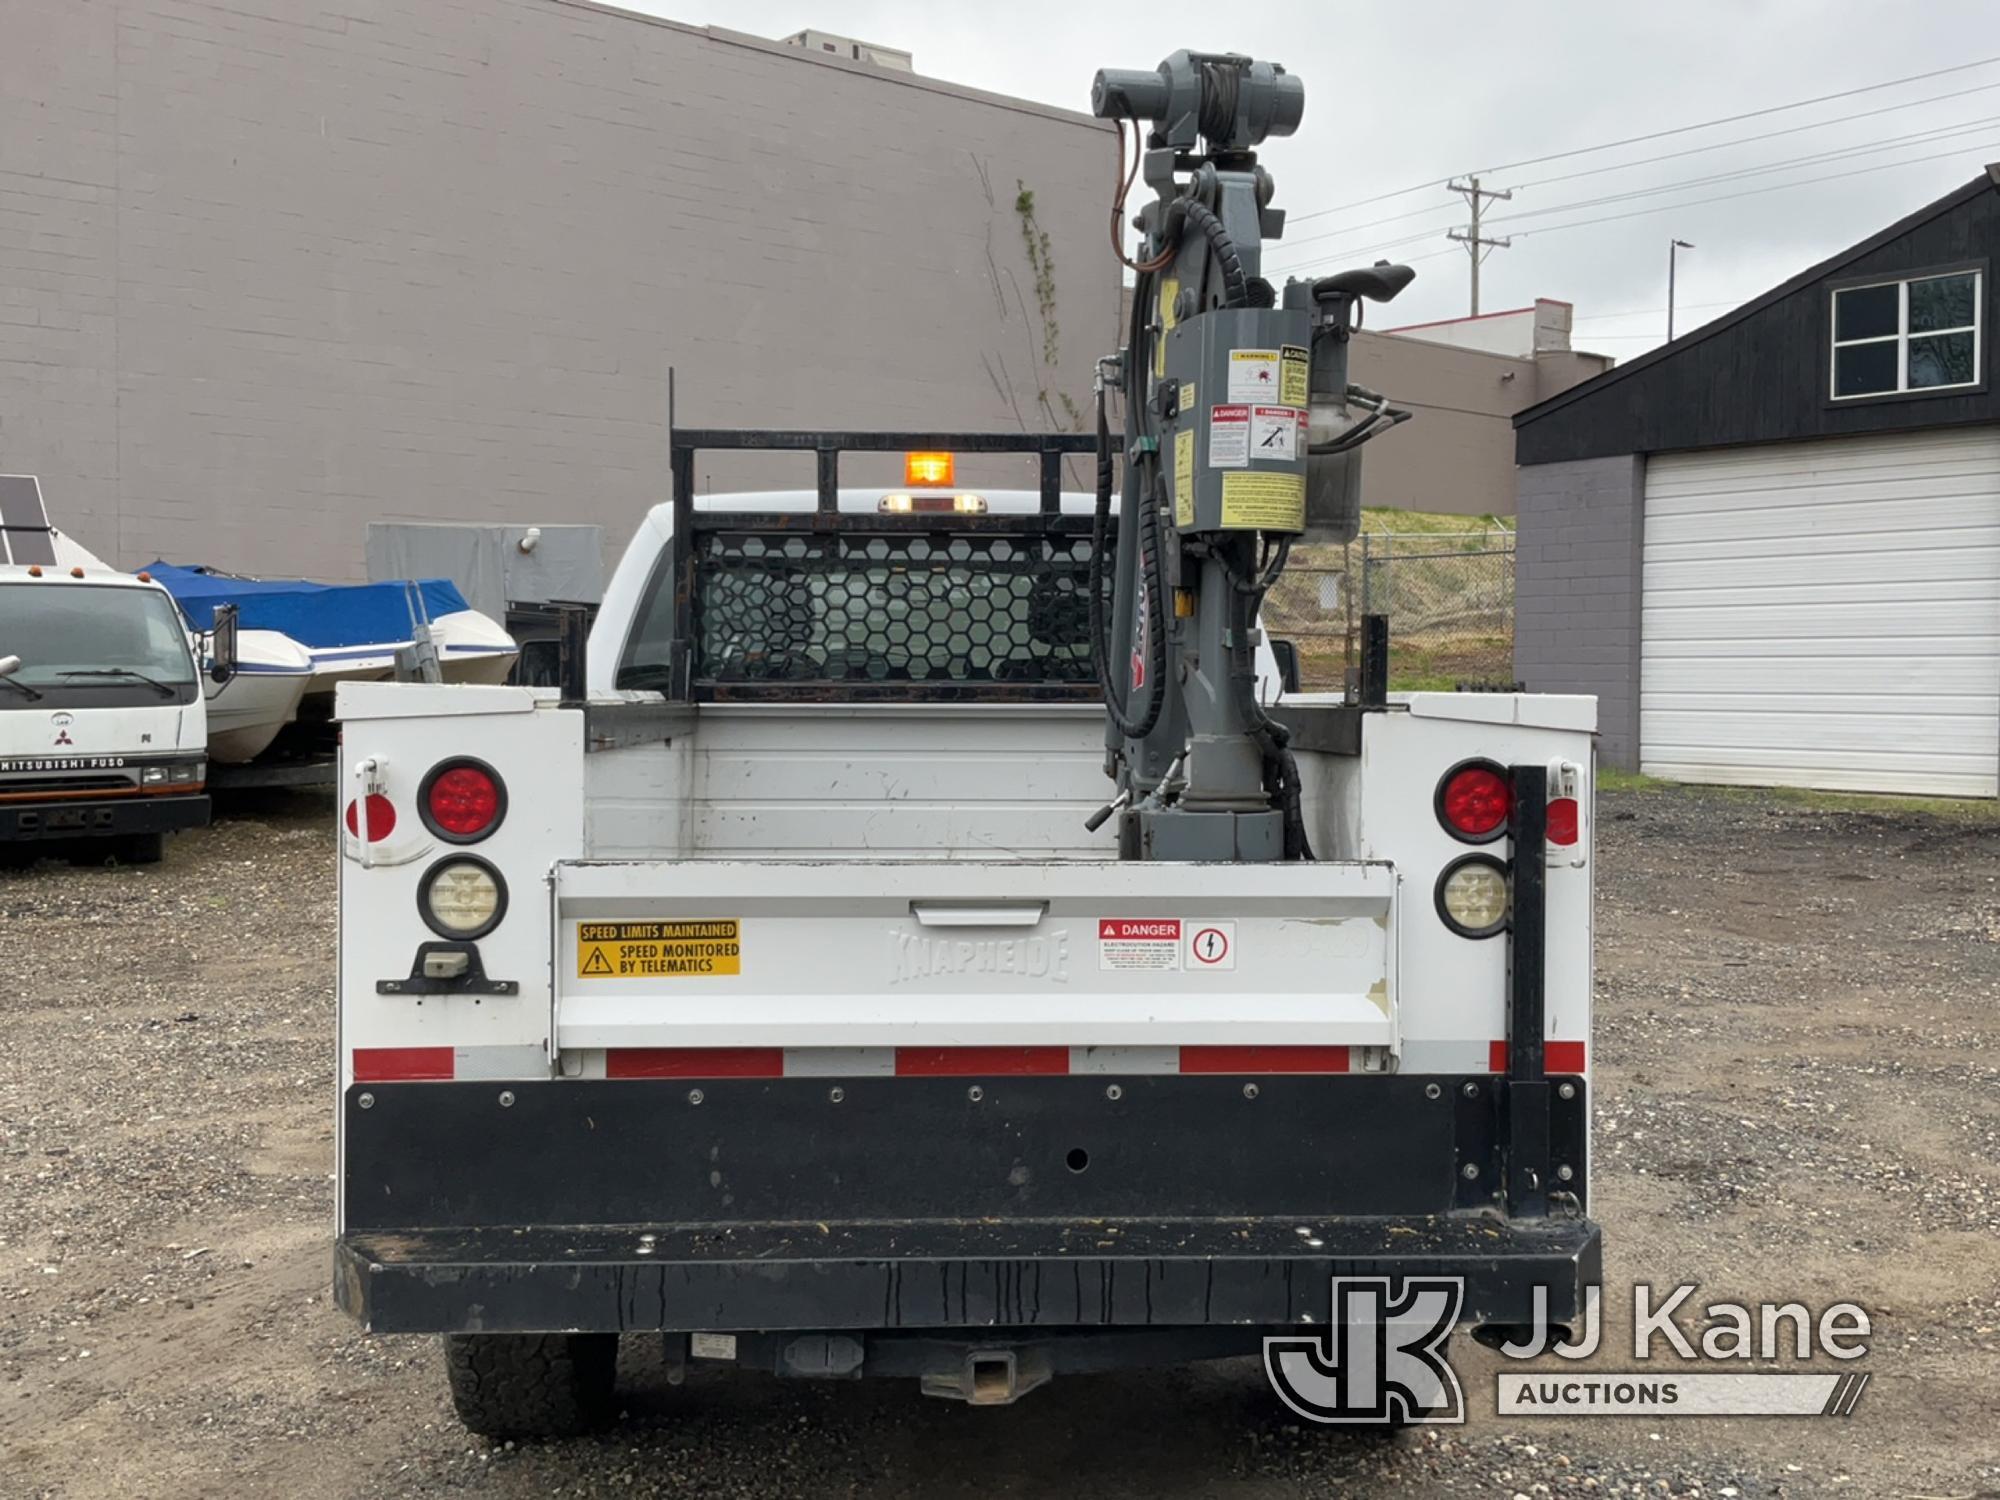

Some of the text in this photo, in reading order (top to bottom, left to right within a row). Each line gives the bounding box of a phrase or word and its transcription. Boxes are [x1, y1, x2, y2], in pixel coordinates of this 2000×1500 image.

[1219, 408, 1248, 417] DANGER
[1, 758, 124, 770] MITSUBISHI FUSO
[582, 923, 735, 939] SPEED LIMITS MAINTAINED
[1121, 924, 1177, 936] DANGER
[620, 943, 740, 958] SPEED MONITORED
[889, 929, 1068, 984] KNAPHEIDE
[620, 959, 713, 973] BY TELEMATICS
